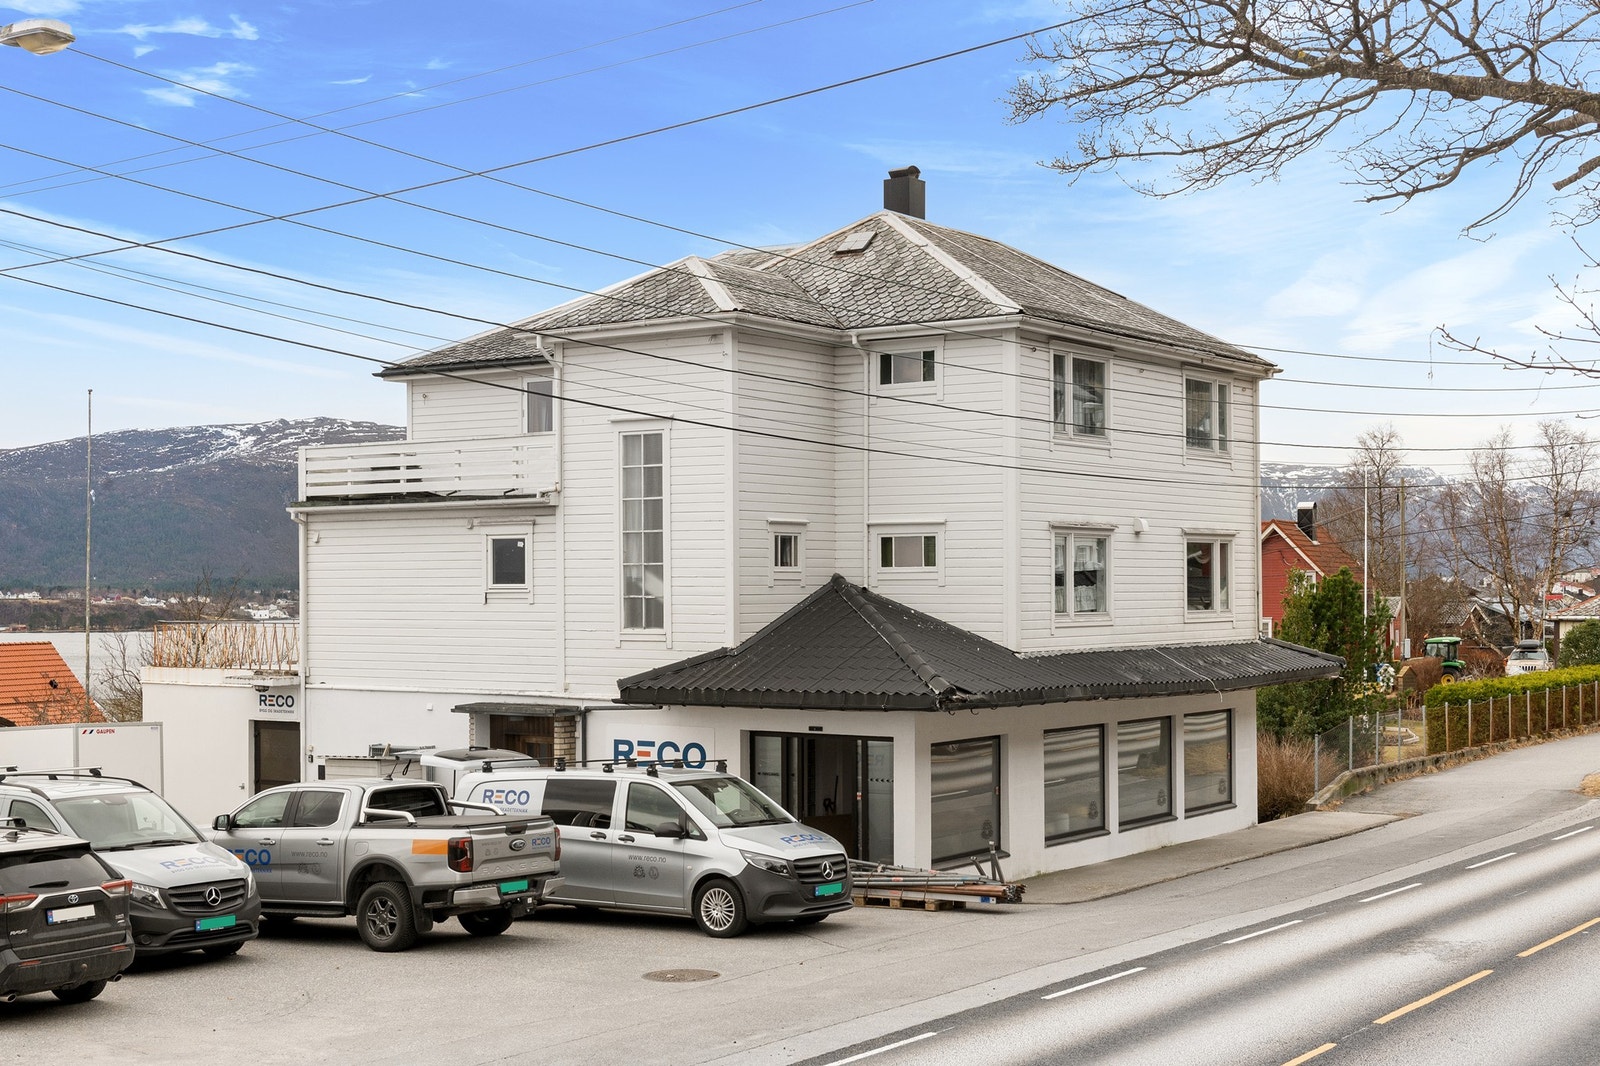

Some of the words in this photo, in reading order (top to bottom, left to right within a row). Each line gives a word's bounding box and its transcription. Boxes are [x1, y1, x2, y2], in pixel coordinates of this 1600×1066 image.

[259, 694, 295, 708] RECO
[613, 739, 707, 770] RECO
[482, 789, 530, 806] RECO
[532, 837, 552, 847] RECO
[780, 833, 824, 844] RECO
[160, 856, 221, 870] RECO
[227, 848, 271, 867] ECO
[628, 855, 667, 863] www.reco.no
